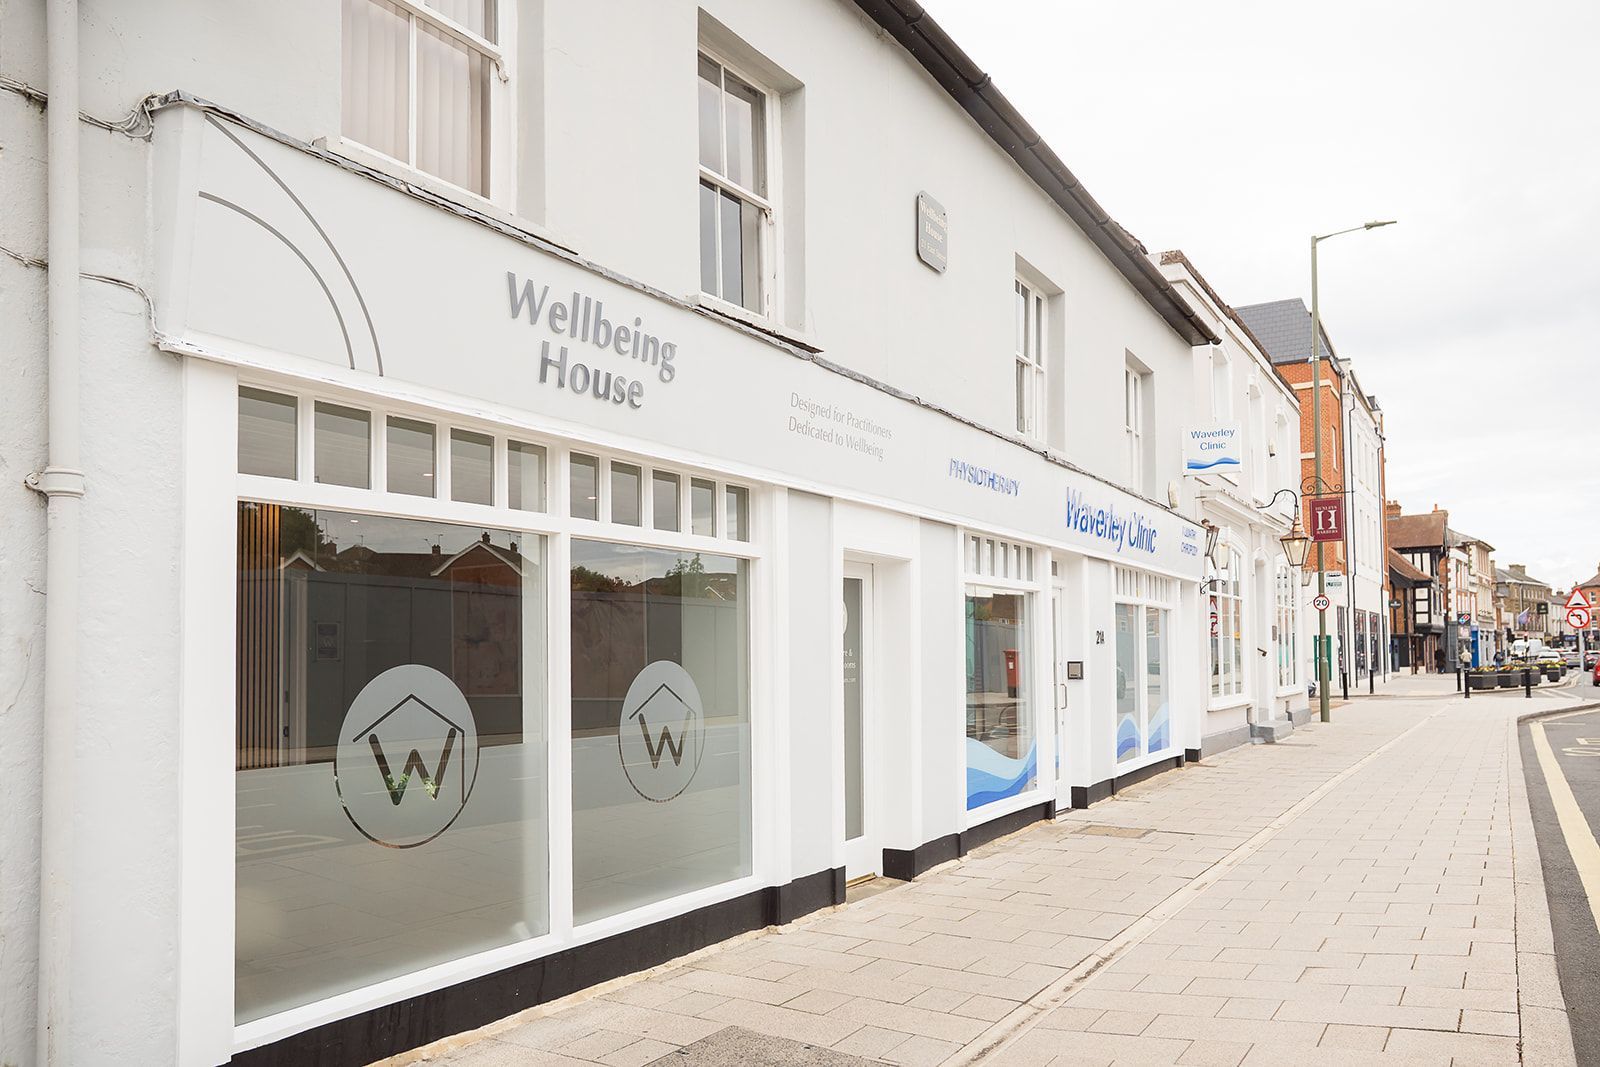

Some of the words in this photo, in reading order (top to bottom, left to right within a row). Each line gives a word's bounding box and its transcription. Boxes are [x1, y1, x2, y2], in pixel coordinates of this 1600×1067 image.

[507, 271, 678, 383] Wellbeing
[538, 340, 645, 409] House
[788, 415, 834, 443] Dedicated
[835, 432, 844, 446] to
[845, 433, 884, 462] Wellbeing
[790, 391, 832, 419] Designed
[833, 406, 846, 424] for
[846, 411, 893, 440] Practitioners
[1190, 428, 1236, 440] Waverley
[1199, 441, 1227, 451] Clinic
[948, 457, 1021, 497] PHYSIOTHERAPY
[1066, 486, 1127, 553] Waverley
[1128, 511, 1158, 554] Clinic
[1315, 599, 1328, 607] 20
